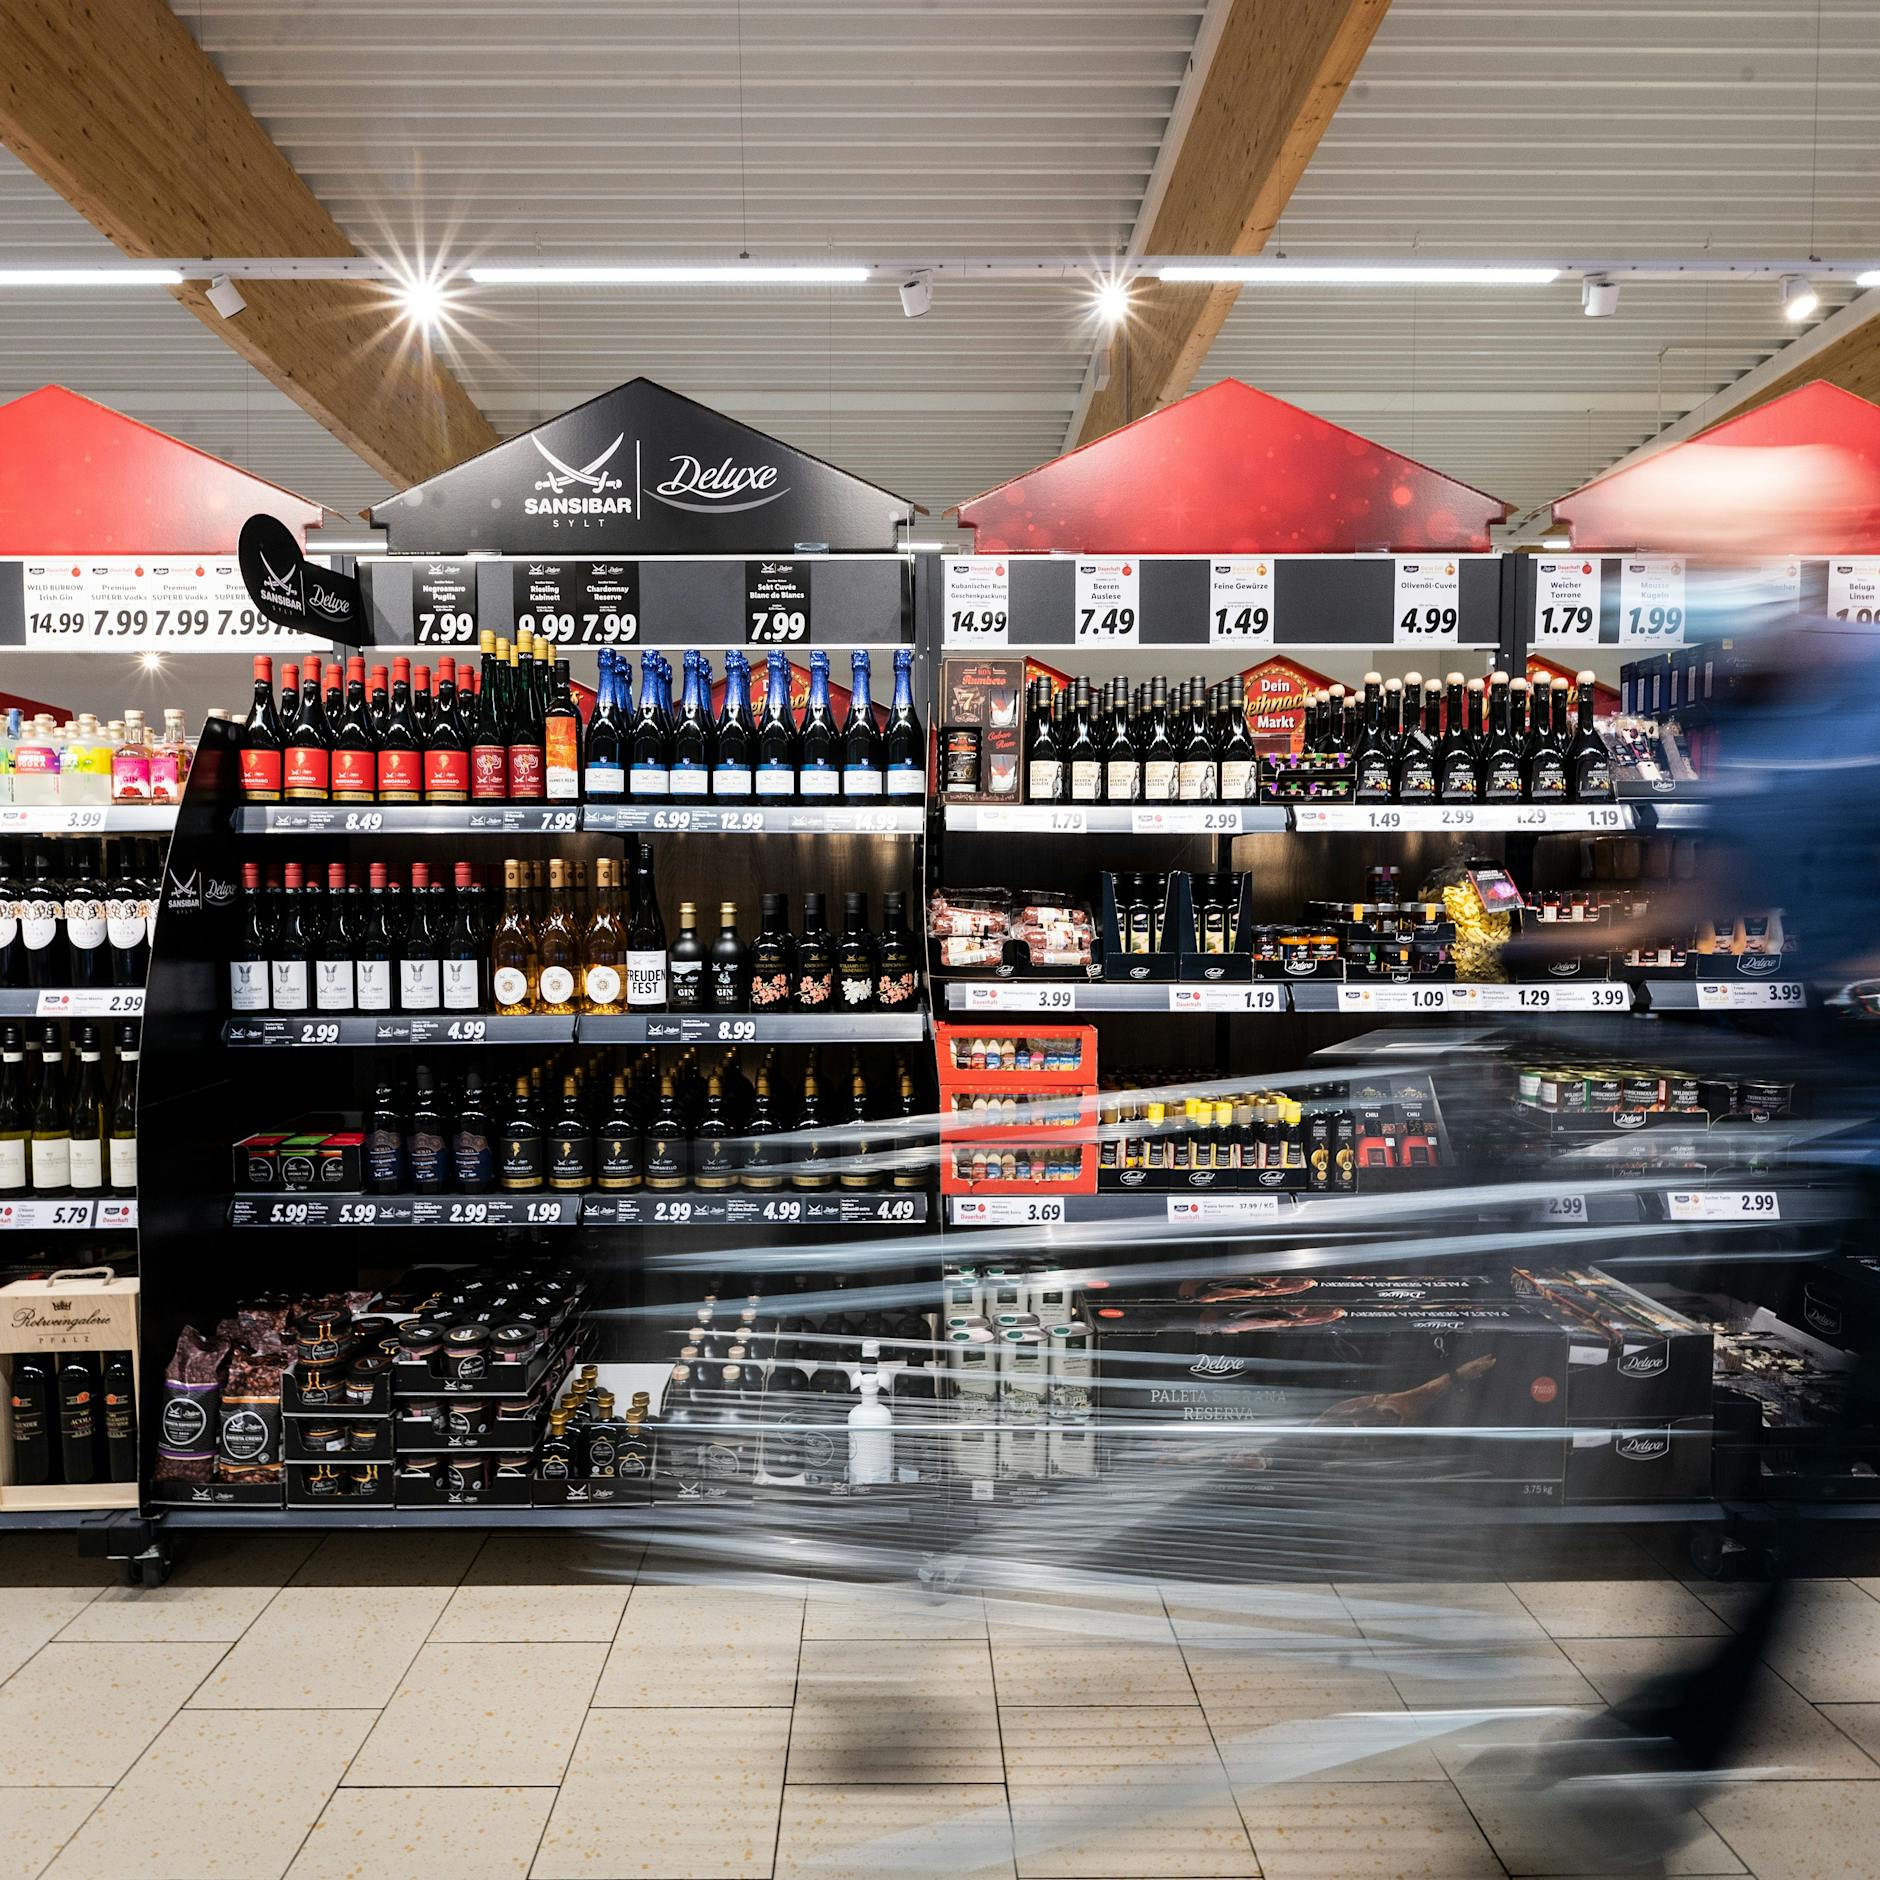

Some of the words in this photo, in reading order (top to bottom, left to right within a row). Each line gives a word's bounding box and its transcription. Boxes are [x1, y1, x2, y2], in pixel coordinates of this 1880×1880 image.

[657, 455, 778, 498] Deluxe
[524, 498, 632, 514] SANSIBAR
[553, 519, 604, 528] SYLT
[422, 585, 466, 593] Negroamaro
[530, 585, 559, 594] Riesling
[586, 585, 629, 594] Chardonnay
[774, 583, 796, 591] Cuvée
[1850, 583, 1875, 592] Beluga
[260, 589, 302, 611] SANSIBAR
[309, 584, 350, 614] Deluxe
[432, 593, 456, 602] Puglia
[30, 613, 84, 634] 14.99
[94, 610, 148, 636] 7.99
[155, 610, 209, 636] 7.99
[218, 610, 270, 635] 7.99
[418, 613, 473, 642] 7.99
[582, 614, 637, 642] 7.99
[751, 612, 806, 641] 7.99
[952, 611, 1007, 633] 14.99
[1080, 608, 1134, 635] 7.49
[1215, 608, 1269, 635] 1.49
[1400, 607, 1457, 634] 4.99
[1542, 607, 1593, 634] 1.79
[1629, 607, 1682, 634] 1.99
[1261, 680, 1290, 692] Dein
[1258, 716, 1295, 729] Markt
[68, 812, 101, 827] 3.99
[346, 813, 383, 830] 8.49
[541, 813, 577, 830] 7.99
[653, 811, 690, 829] 6.99
[721, 813, 764, 830] 12.99
[1050, 814, 1082, 829] 1.79
[1205, 814, 1237, 828] 2.99
[1368, 813, 1400, 827] 1.49
[1442, 810, 1474, 824] 2.99
[1588, 811, 1618, 826] 1.19
[1743, 955, 1777, 970] Deluxe
[626, 969, 666, 982] FREUDEN
[633, 982, 658, 994] FEST
[1769, 985, 1801, 1000] 3.99
[109, 997, 143, 1011] 2.99
[1038, 991, 1071, 1007] 3.99
[1244, 991, 1275, 1008] 1.19
[1412, 992, 1444, 1007] 1.09
[1518, 990, 1550, 1006] 1.29
[1592, 990, 1624, 1006] 3.99
[301, 1025, 339, 1043] 2.99
[448, 1022, 486, 1040] 4.99
[718, 1022, 755, 1040] 8.99
[654, 1202, 691, 1221] 2.99
[763, 1202, 801, 1220] 4.99
[878, 1201, 914, 1219] 4.49
[1550, 1198, 1582, 1214] 2.99
[1742, 1195, 1774, 1211] 2.99
[53, 1207, 88, 1224] 5.79
[270, 1204, 307, 1222] 5.99
[339, 1204, 376, 1222] 5.99
[450, 1204, 487, 1222] 2.99
[527, 1203, 561, 1222] 1.99
[1028, 1204, 1060, 1220] 3.69
[12, 1307, 111, 1331] Rotweingalerie
[1190, 1353, 1246, 1374] Deluxe
[1623, 1356, 1663, 1370] Deluxe
[1150, 1390, 1207, 1403] PALETA
[1183, 1407, 1255, 1421] RESERVA
[1622, 1439, 1663, 1453] Deluxe
[1543, 1485, 1553, 1495] kg
